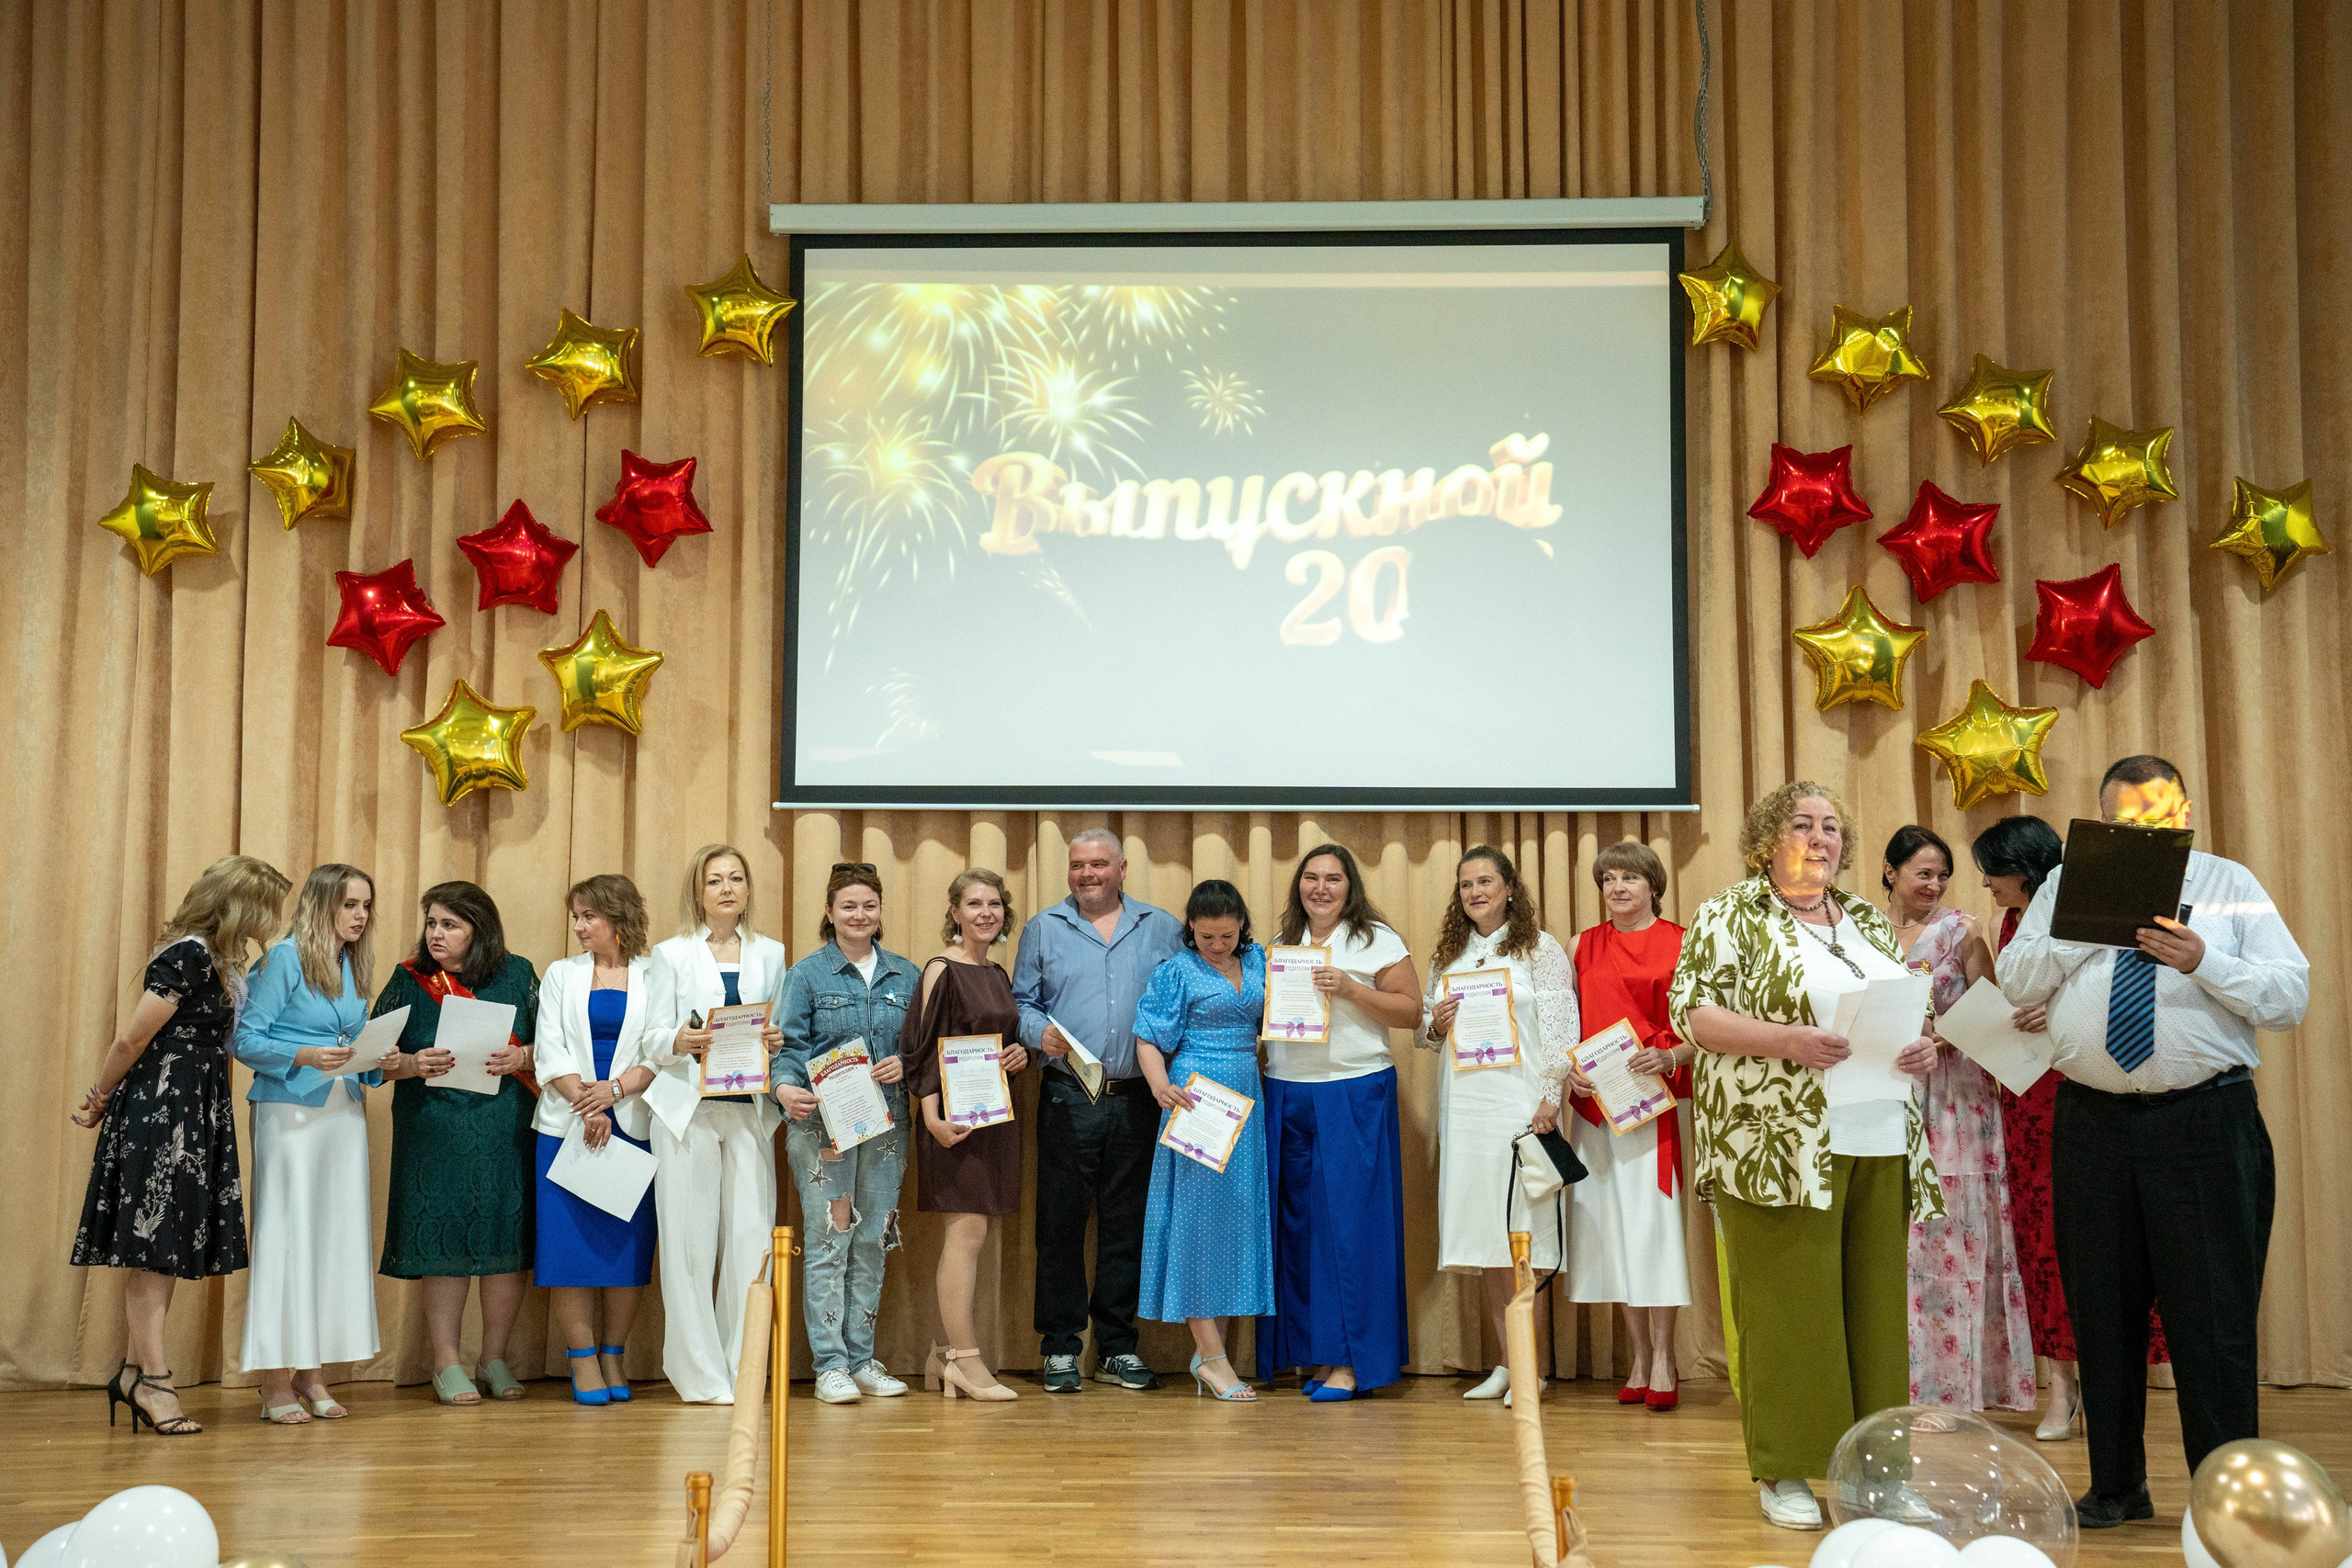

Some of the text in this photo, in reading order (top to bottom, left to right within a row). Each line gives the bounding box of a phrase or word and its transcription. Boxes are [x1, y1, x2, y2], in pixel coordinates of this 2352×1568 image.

[972, 433, 1564, 570] Выпускной
[1280, 546, 1410, 646] 20
[1452, 982, 1503, 992] БЛАГОДАРНОСТЬ
[715, 1012, 763, 1023] БЛАГОДАРНОСТЬ
[946, 1047, 995, 1055] БЛАГОДАРНОСТЬ
[1580, 1034, 1628, 1064] БЛАГОДАРНОСТЬ
[820, 1056, 859, 1077] БЛАГОДАРНОСТЬ
[828, 1066, 855, 1081] РОДИТЕЛЯМ
[1193, 1087, 1240, 1113] БЛАГОДАРНОСТЬ
